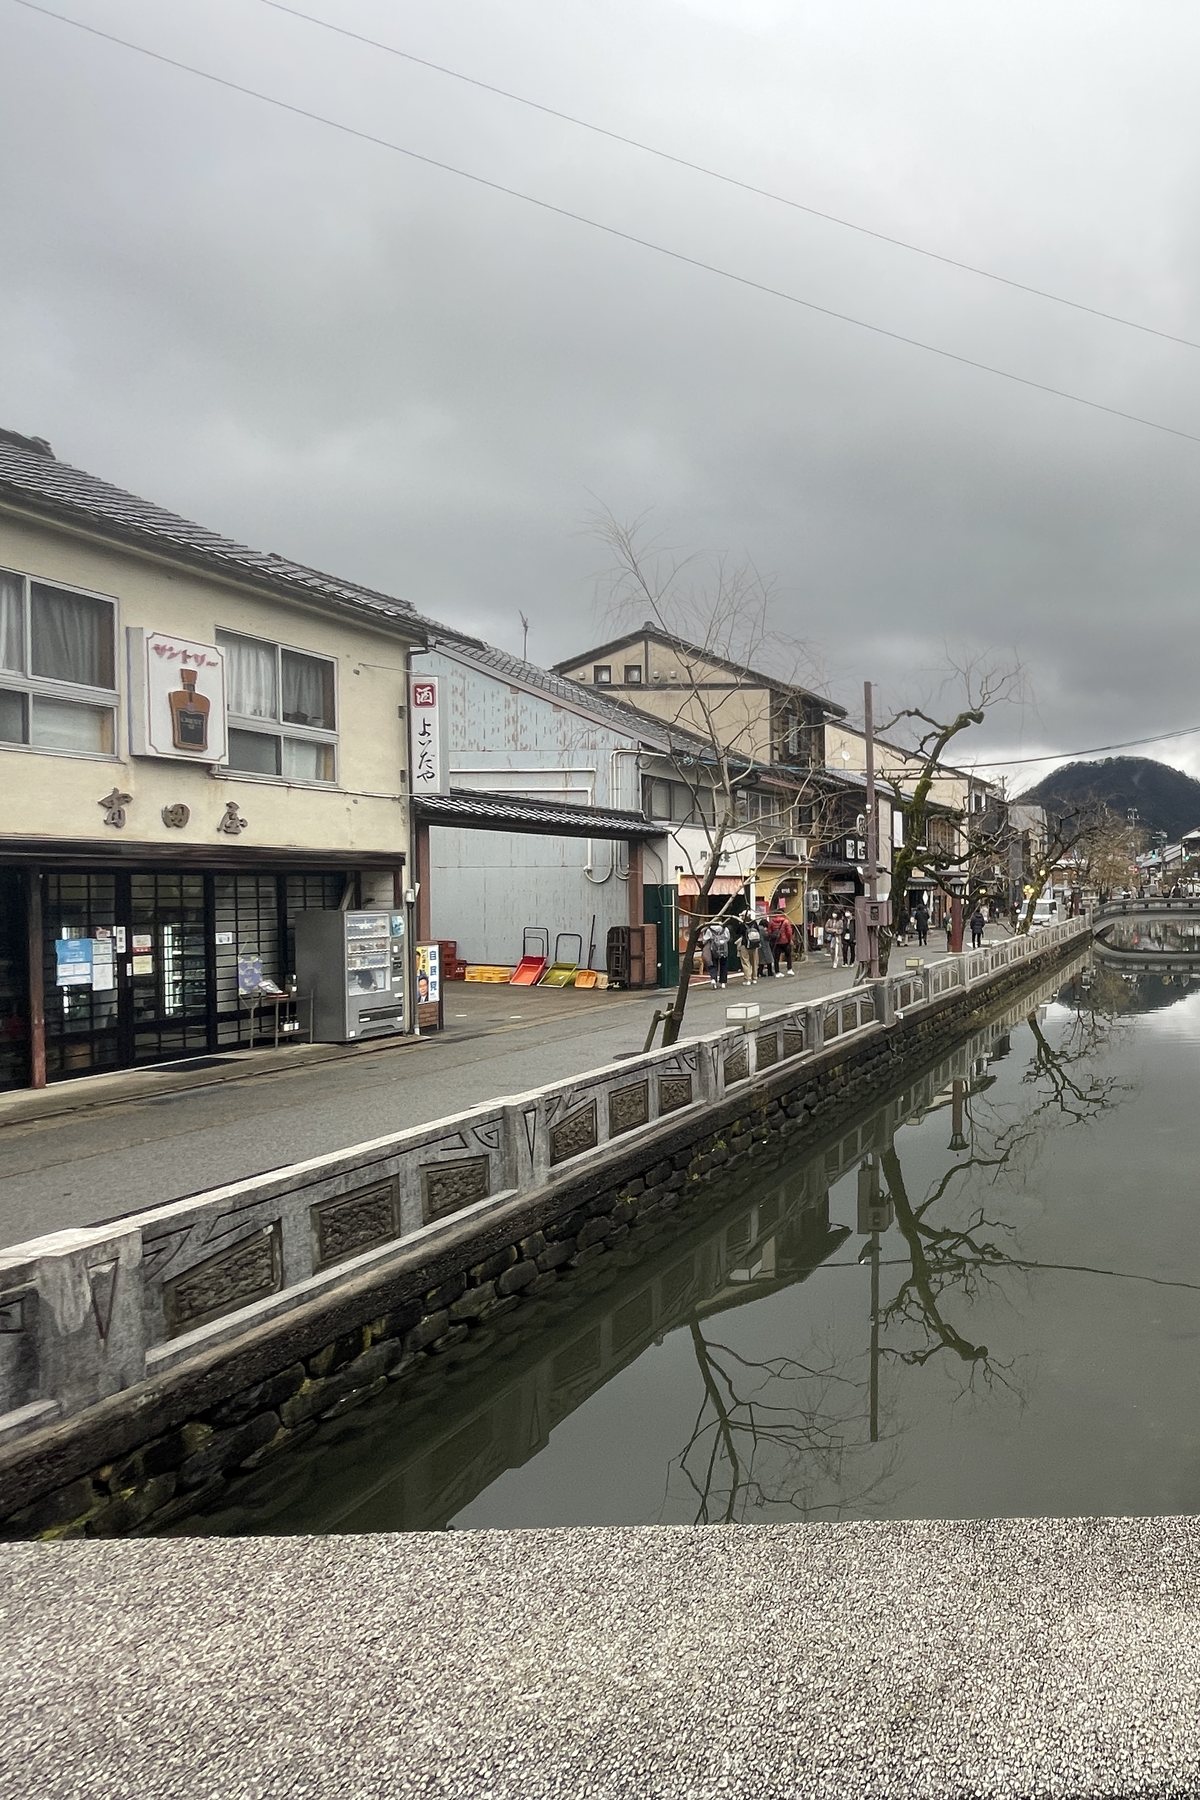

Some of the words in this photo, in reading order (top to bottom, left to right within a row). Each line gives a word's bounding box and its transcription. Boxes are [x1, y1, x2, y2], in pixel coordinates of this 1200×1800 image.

[152, 643, 219, 667] サントリー
[415, 686, 433, 705] 酒
